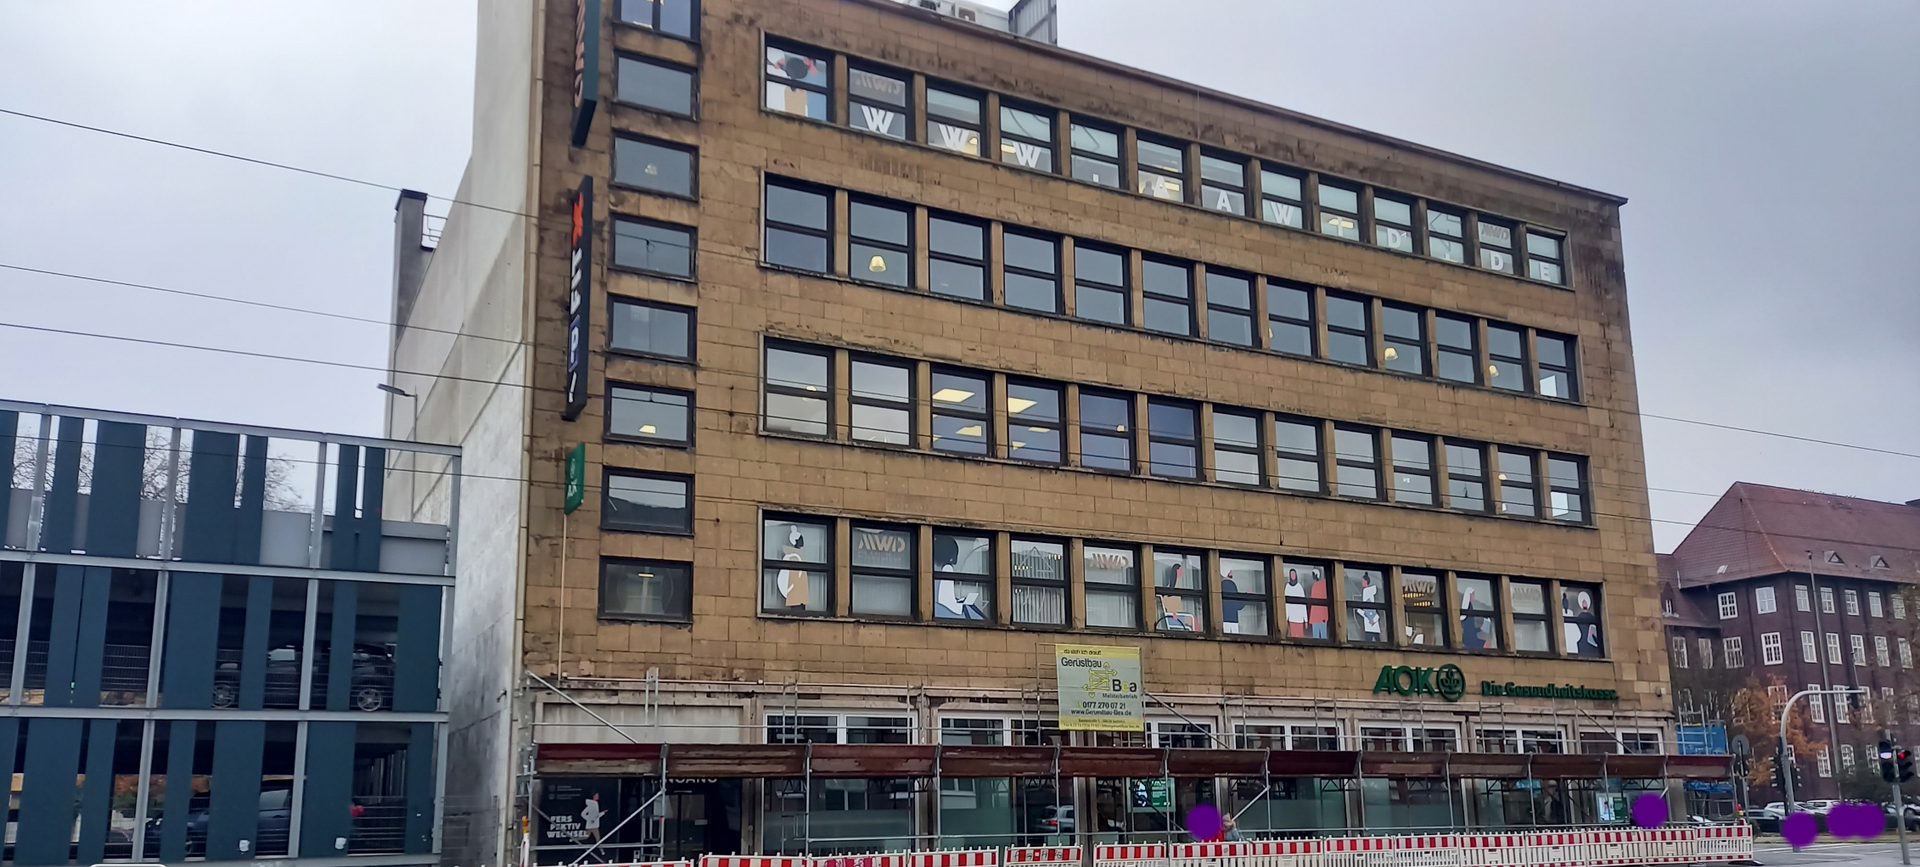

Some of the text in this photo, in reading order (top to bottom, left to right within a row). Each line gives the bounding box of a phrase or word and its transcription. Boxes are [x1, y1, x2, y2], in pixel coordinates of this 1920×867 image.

[1061, 657, 1102, 668] Gerüstbau
[1112, 679, 1138, 693] Bea
[1373, 665, 1436, 696] AOK
[1481, 680, 1503, 696] Die
[1082, 701, 1097, 709] 0177
[1097, 701, 1110, 709] 270
[1119, 702, 1126, 710] 21
[550, 815, 573, 823] PERS
